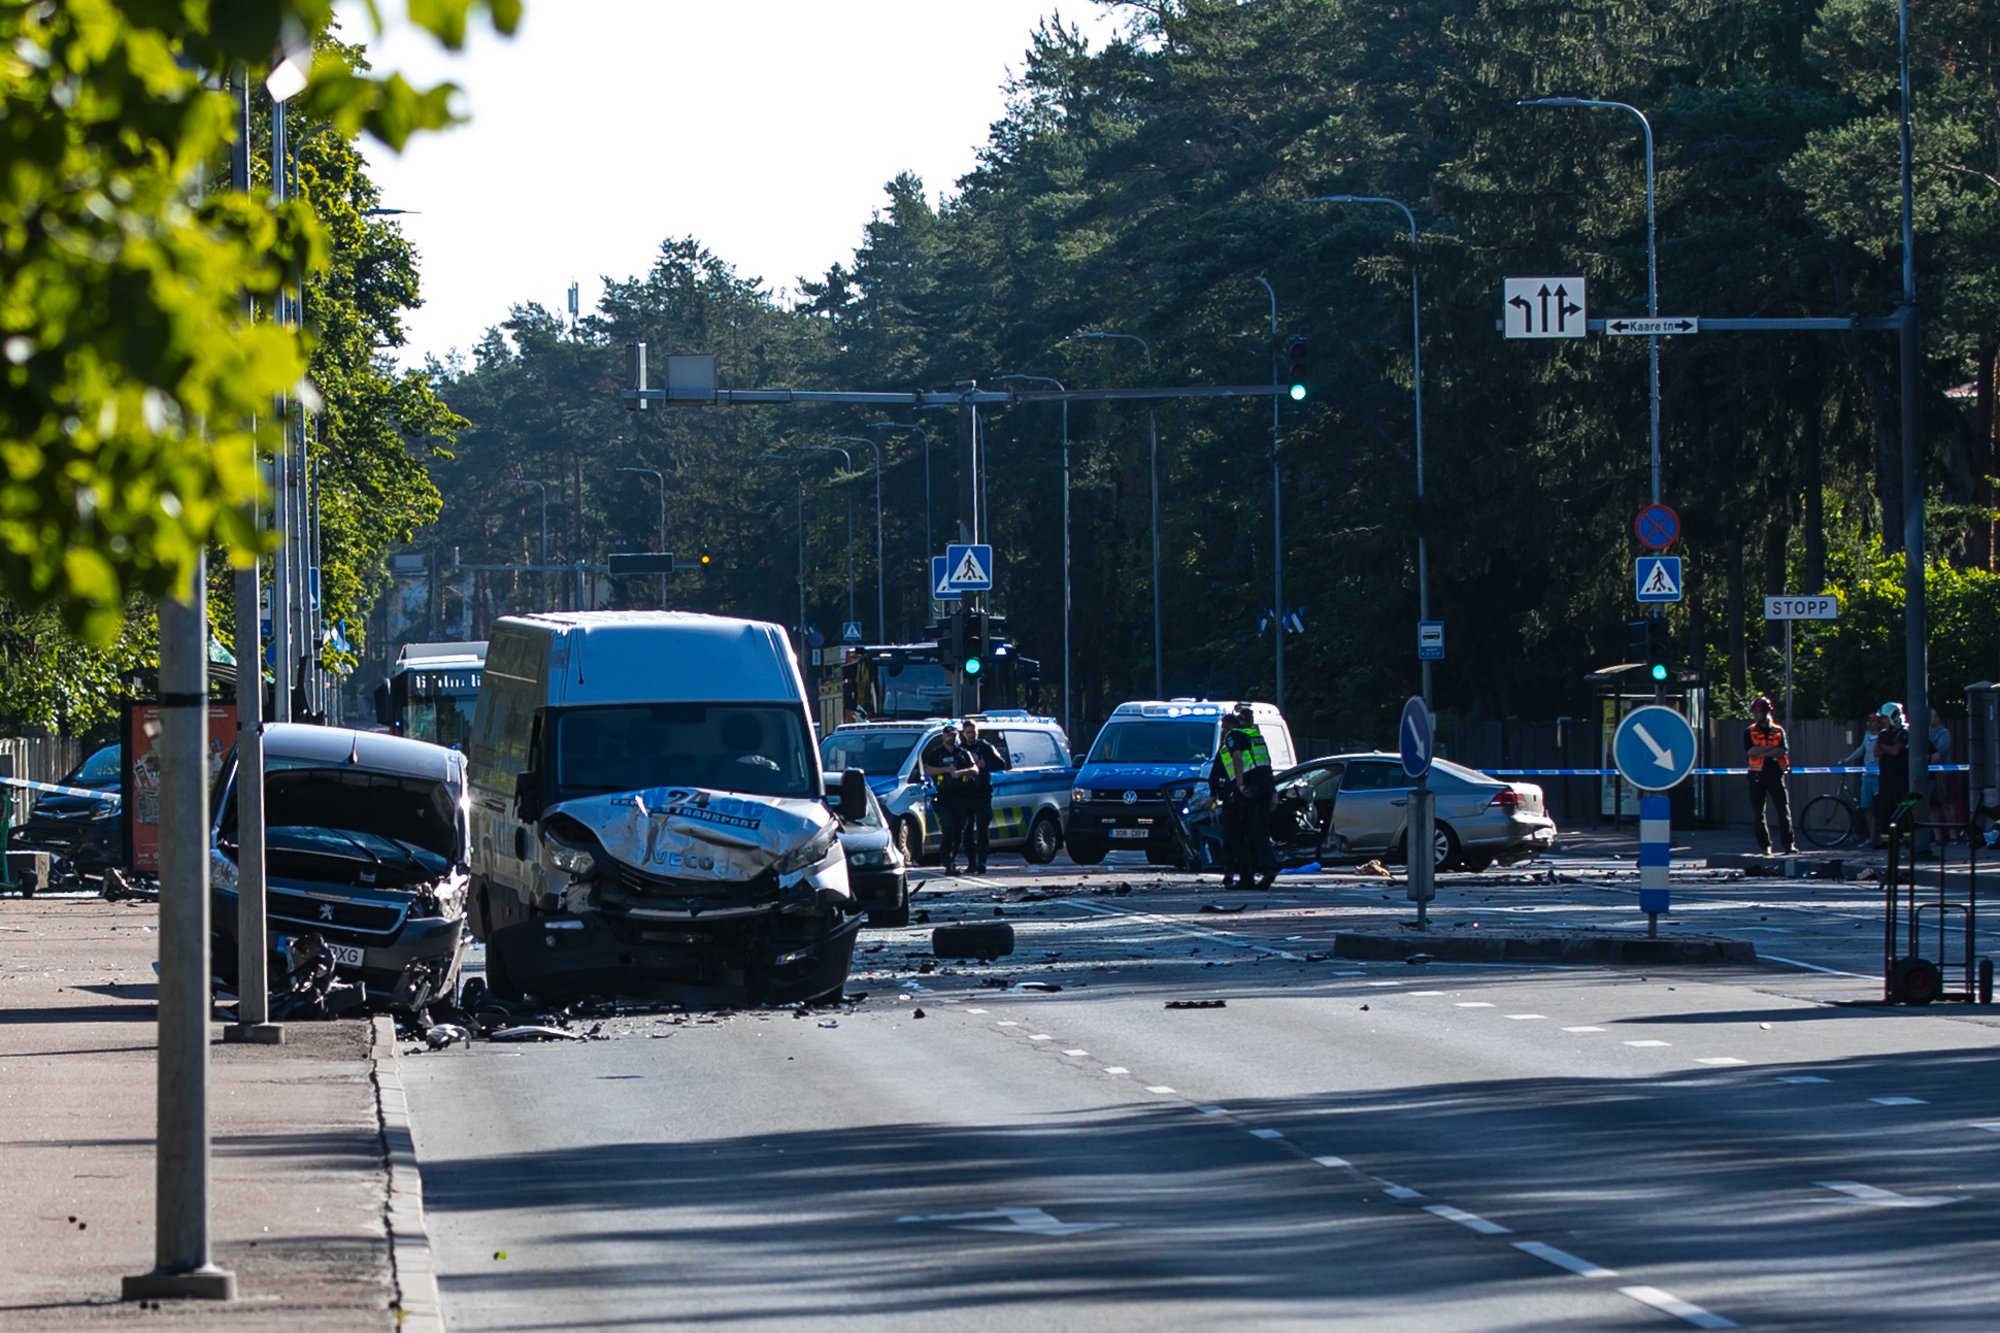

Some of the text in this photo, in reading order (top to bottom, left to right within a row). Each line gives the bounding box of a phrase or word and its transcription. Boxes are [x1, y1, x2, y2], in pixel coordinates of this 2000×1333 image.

[1630, 321, 1674, 332] Kaare tn
[1772, 601, 1828, 615] STOPP
[674, 807, 760, 830] TRANSPORT
